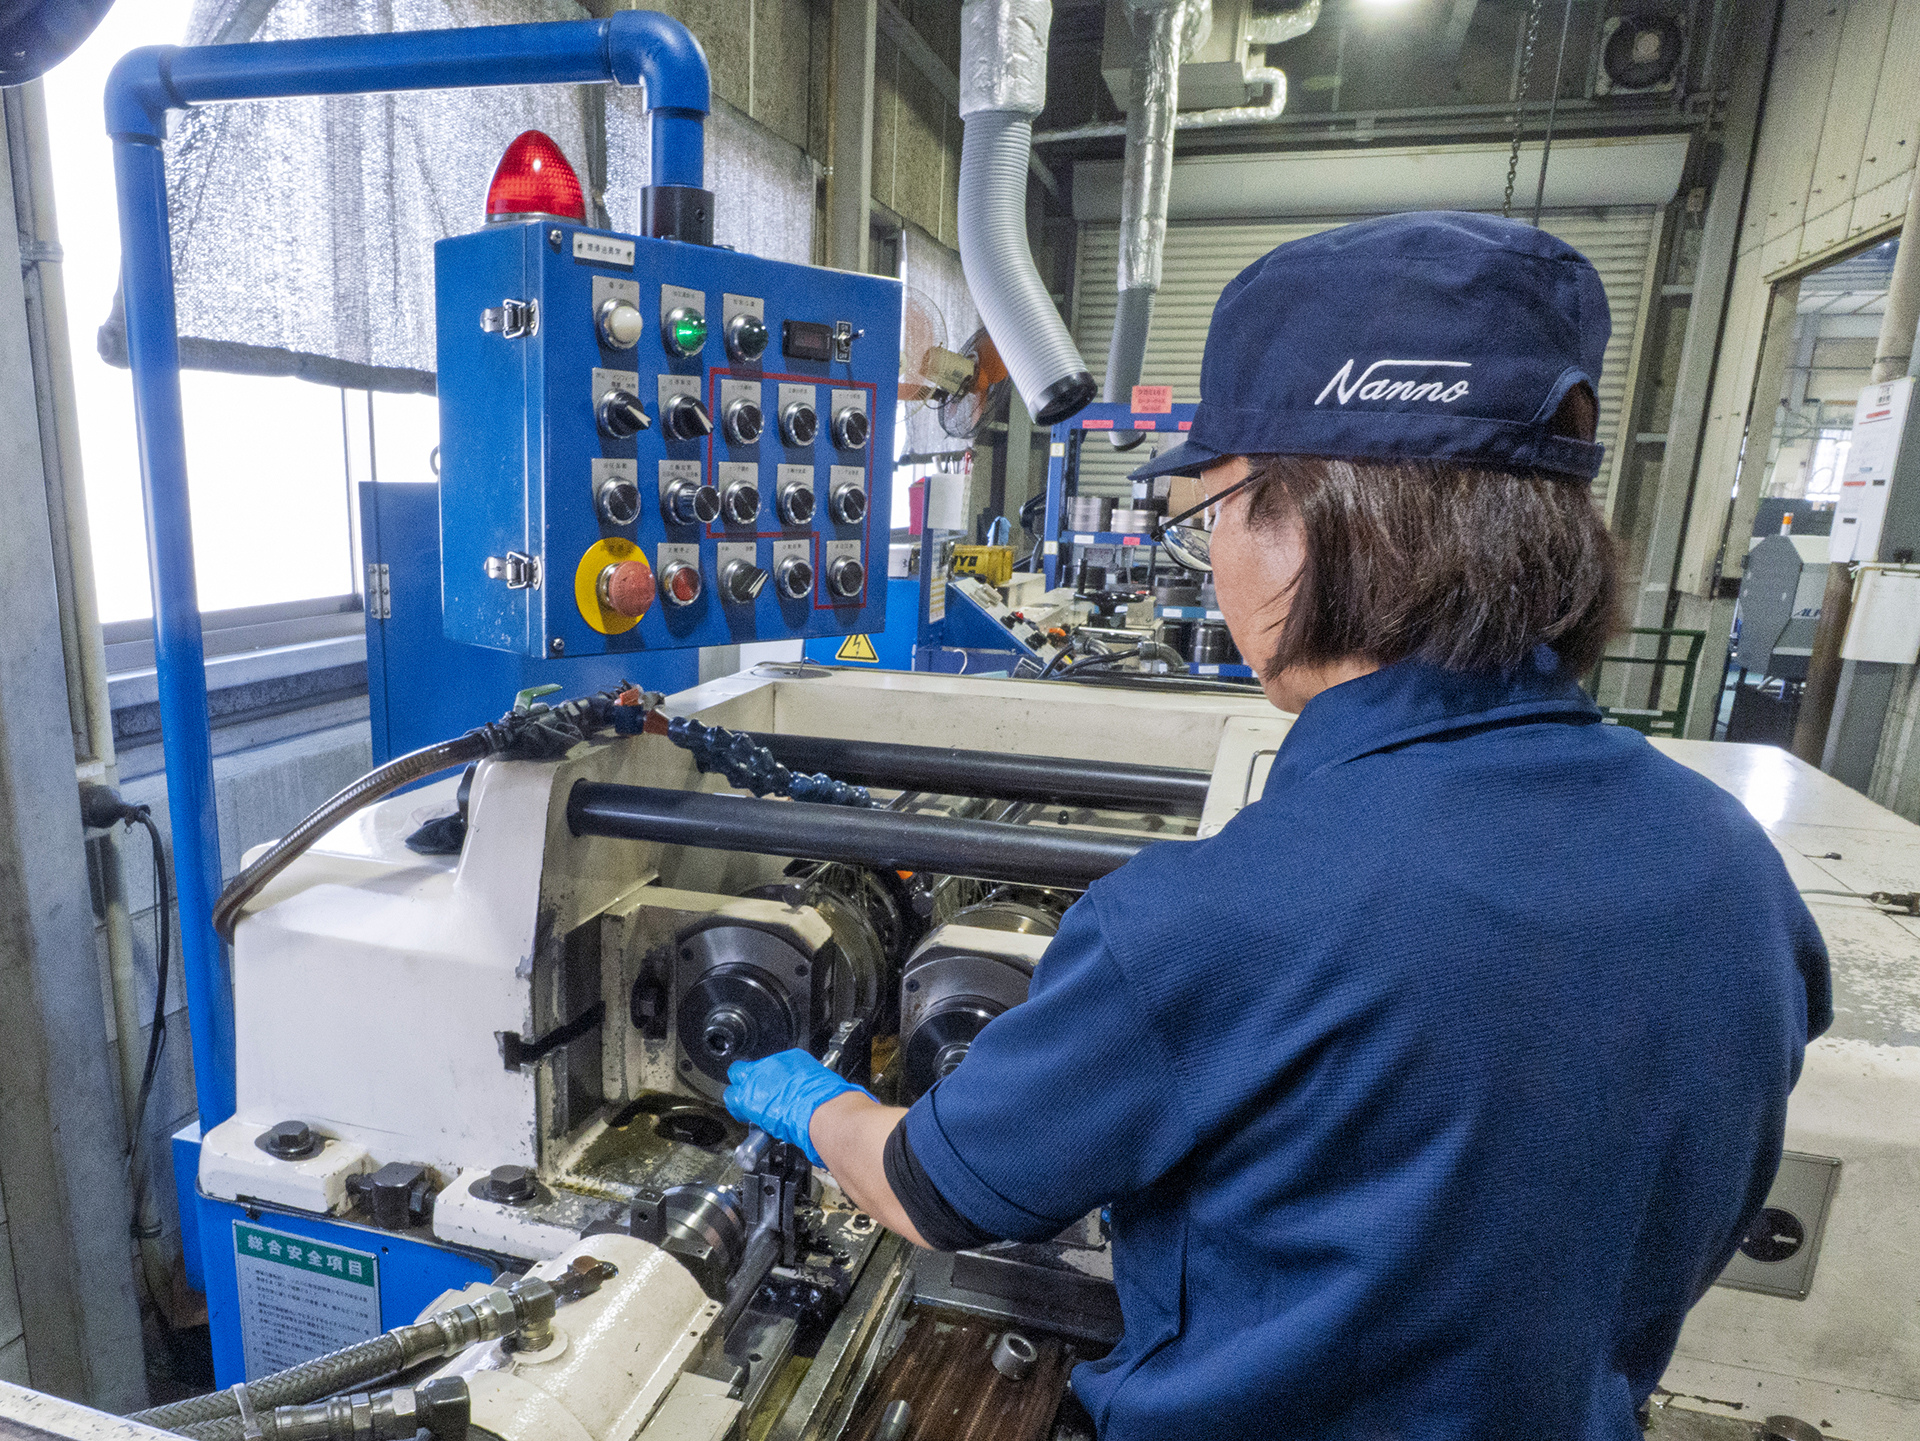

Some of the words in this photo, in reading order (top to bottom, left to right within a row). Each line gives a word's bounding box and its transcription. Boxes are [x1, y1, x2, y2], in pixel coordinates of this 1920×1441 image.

[1314, 358, 1472, 406] Nanno
[247, 1233, 363, 1278] 総合安全項目
